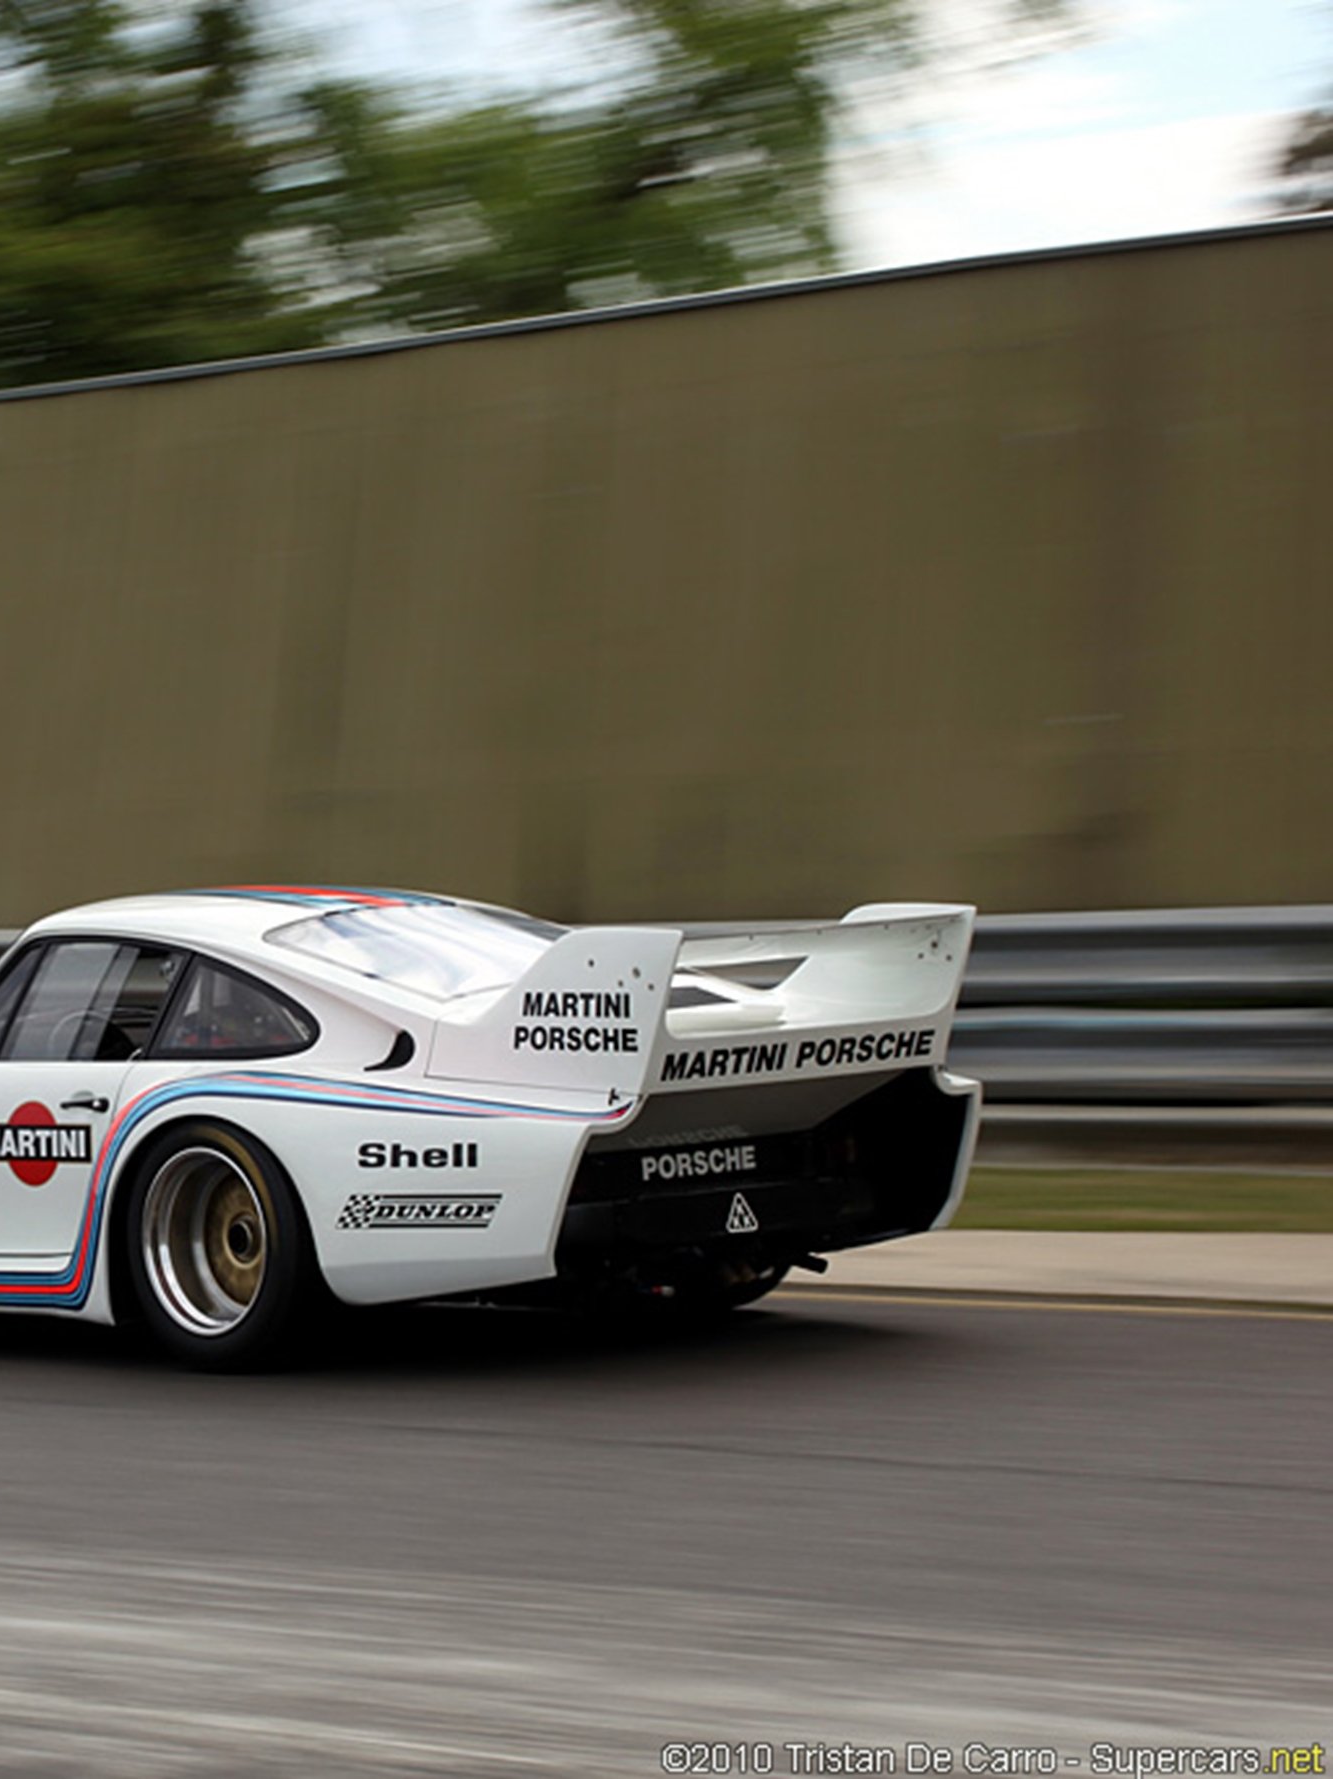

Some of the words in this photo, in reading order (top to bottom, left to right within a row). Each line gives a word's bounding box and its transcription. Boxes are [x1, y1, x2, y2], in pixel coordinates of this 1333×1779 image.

[522, 992, 631, 1019] MARTINI
[513, 1025, 639, 1053] PORSCHE
[660, 1042, 787, 1082] MARTINI
[796, 1029, 936, 1069] PORSCHE
[357, 1142, 479, 1168] Shell
[641, 1145, 757, 1181] PORSCHE
[373, 1204, 496, 1219] DUNLOP
